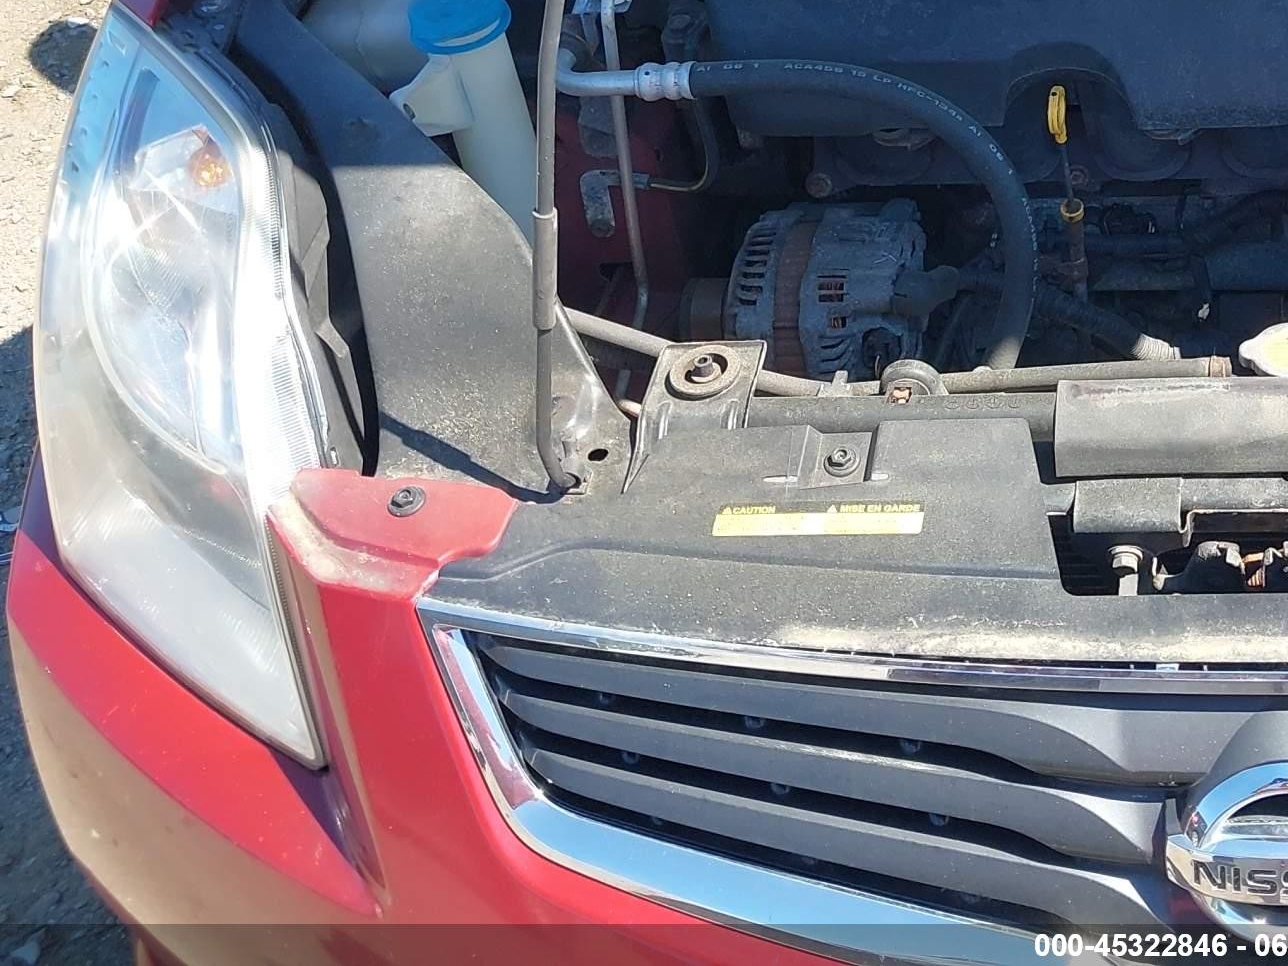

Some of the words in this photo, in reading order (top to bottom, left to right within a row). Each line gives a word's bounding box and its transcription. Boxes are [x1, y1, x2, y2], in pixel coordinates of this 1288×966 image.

[733, 505, 776, 515] CAUTION
[839, 504, 866, 513] MISE
[867, 504, 882, 513] EN
[883, 503, 921, 513] GARDE
